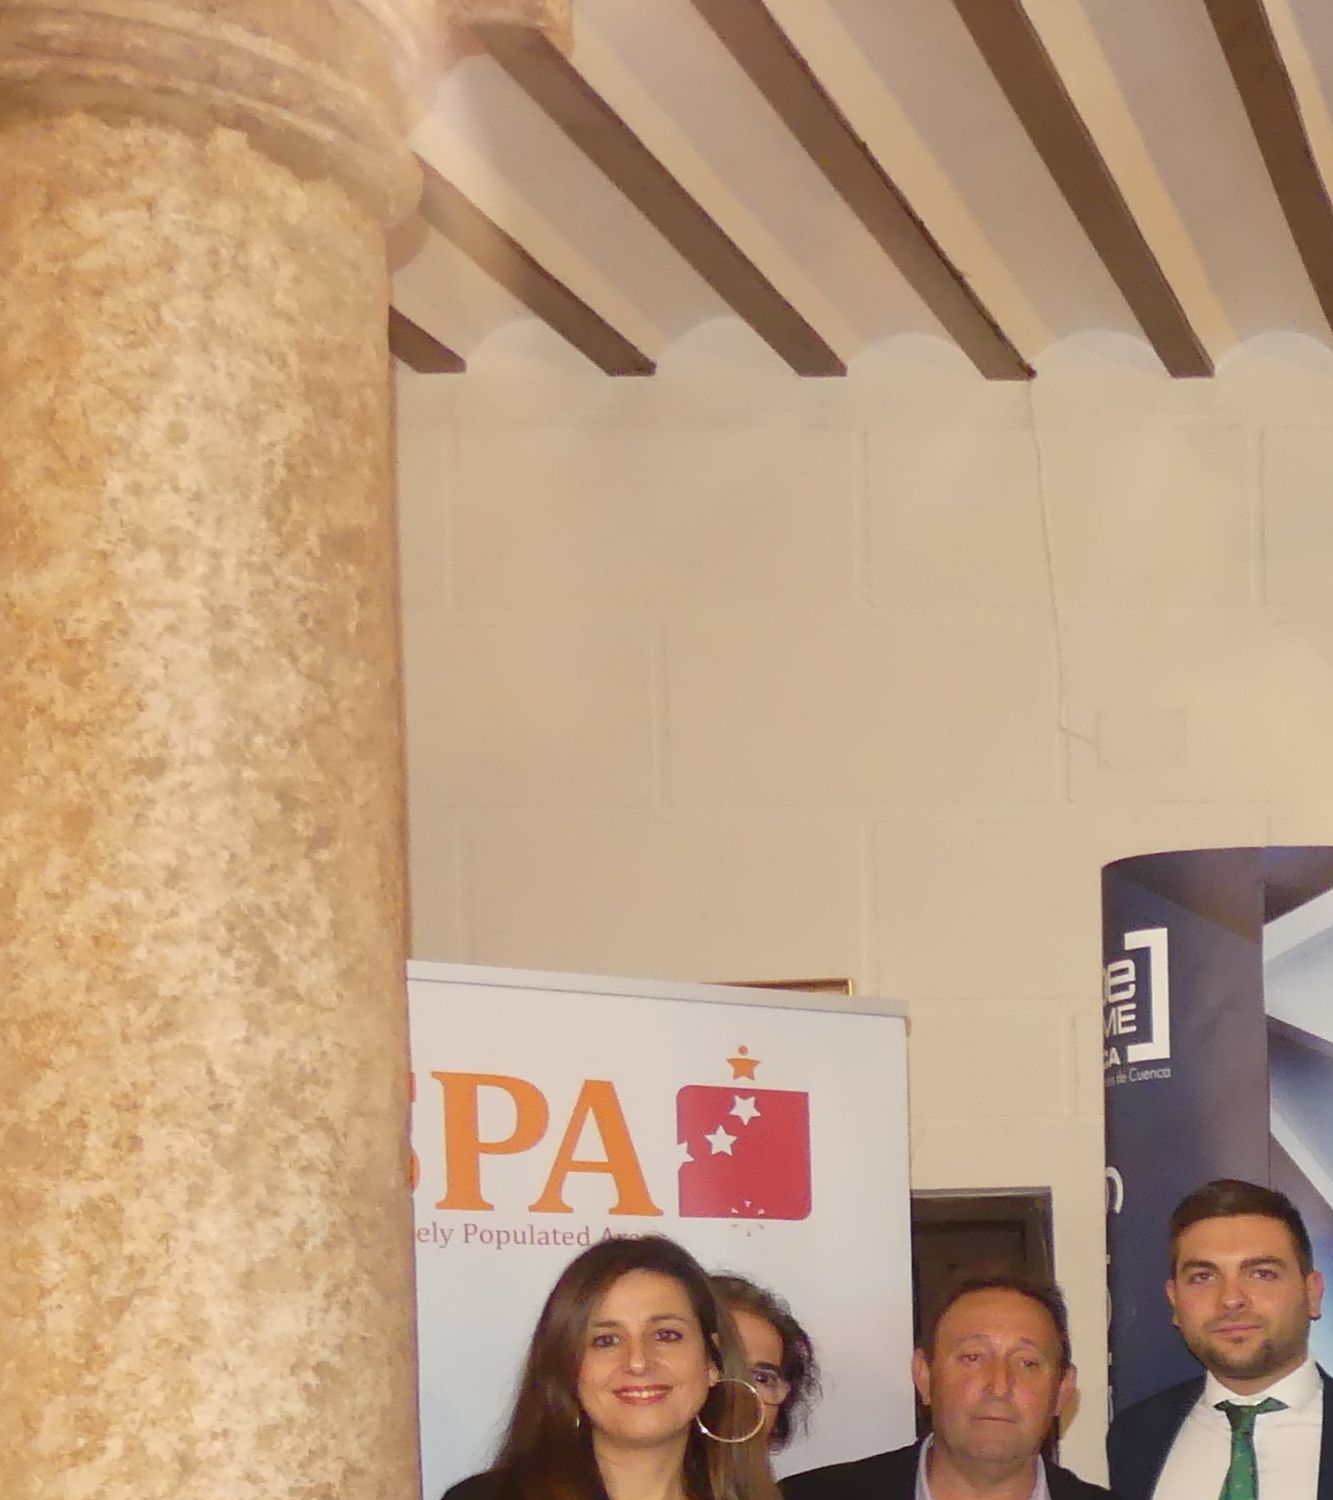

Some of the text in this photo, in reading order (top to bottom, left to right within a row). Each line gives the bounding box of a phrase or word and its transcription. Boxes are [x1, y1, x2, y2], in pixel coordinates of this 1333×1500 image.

[1128, 1067, 1172, 1082] Cuenca
[416, 1221, 455, 1249] ely
[463, 1222, 591, 1250] Populated
